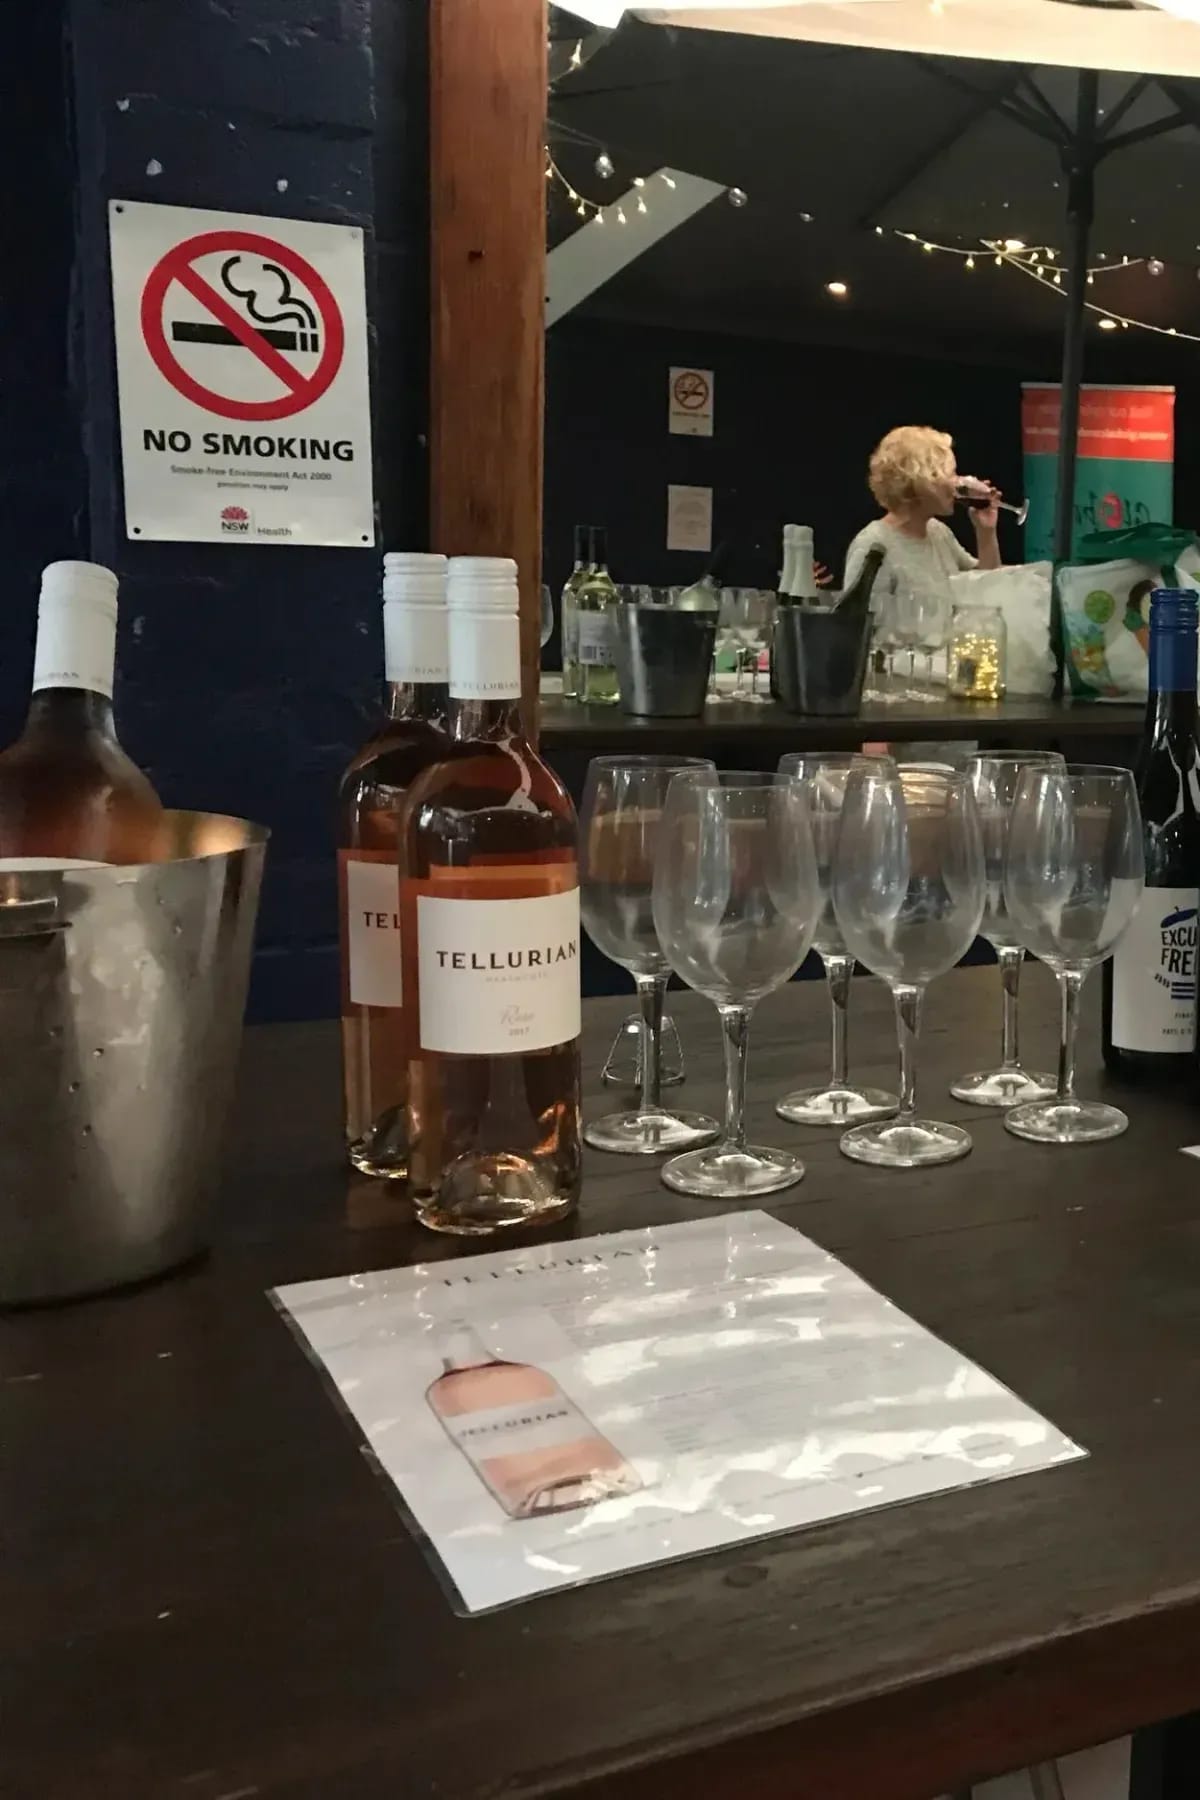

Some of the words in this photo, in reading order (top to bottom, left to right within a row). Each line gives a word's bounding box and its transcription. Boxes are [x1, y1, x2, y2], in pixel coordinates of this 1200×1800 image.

[143, 429, 191, 452] NO
[203, 432, 354, 462] SMOKING
[229, 468, 289, 480] Environment
[292, 471, 307, 480] Act
[310, 472, 332, 481] 2000
[221, 522, 249, 531] NSW
[257, 528, 292, 537] Health
[1161, 926, 1197, 947] EXCU
[436, 940, 577, 970] TELLURIAN
[1161, 948, 1197, 976] FRE
